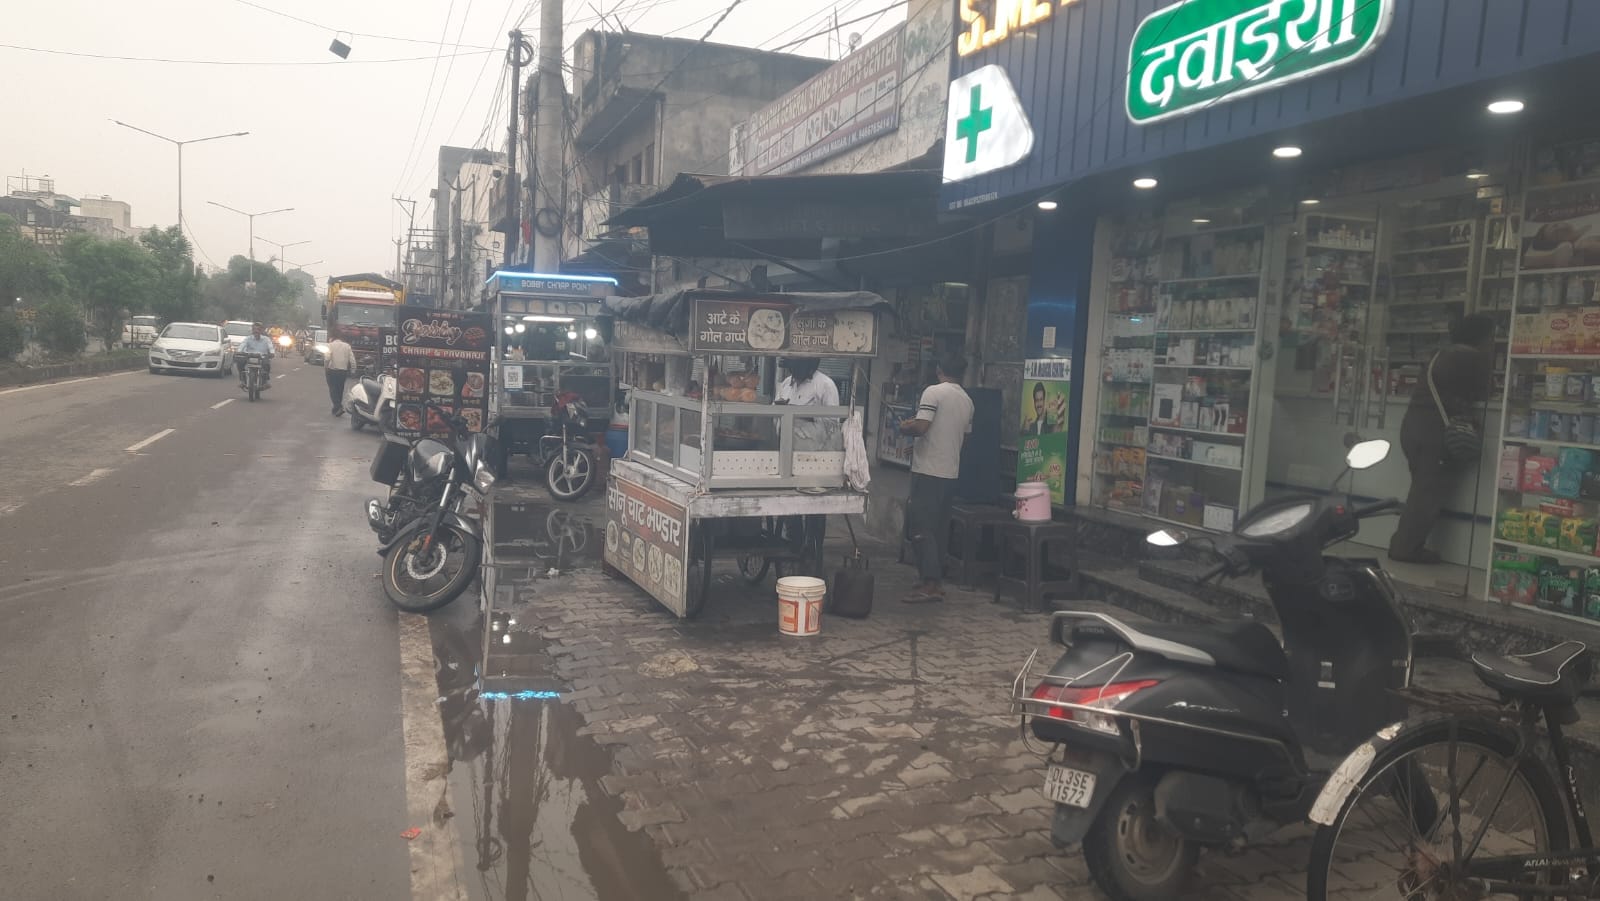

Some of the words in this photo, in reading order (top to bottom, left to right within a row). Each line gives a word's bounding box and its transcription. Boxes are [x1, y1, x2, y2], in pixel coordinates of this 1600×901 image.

[809, 77, 831, 108] STORE
[521, 280, 545, 289] BOBBY
[706, 310, 727, 325] आटे
[729, 310, 741, 325] के
[700, 327, 722, 343] गोल
[724, 329, 746, 343] गप्पे
[627, 496, 646, 526] चाट
[646, 506, 682, 547] भण्डार
[1052, 767, 1090, 791] DL3SE
